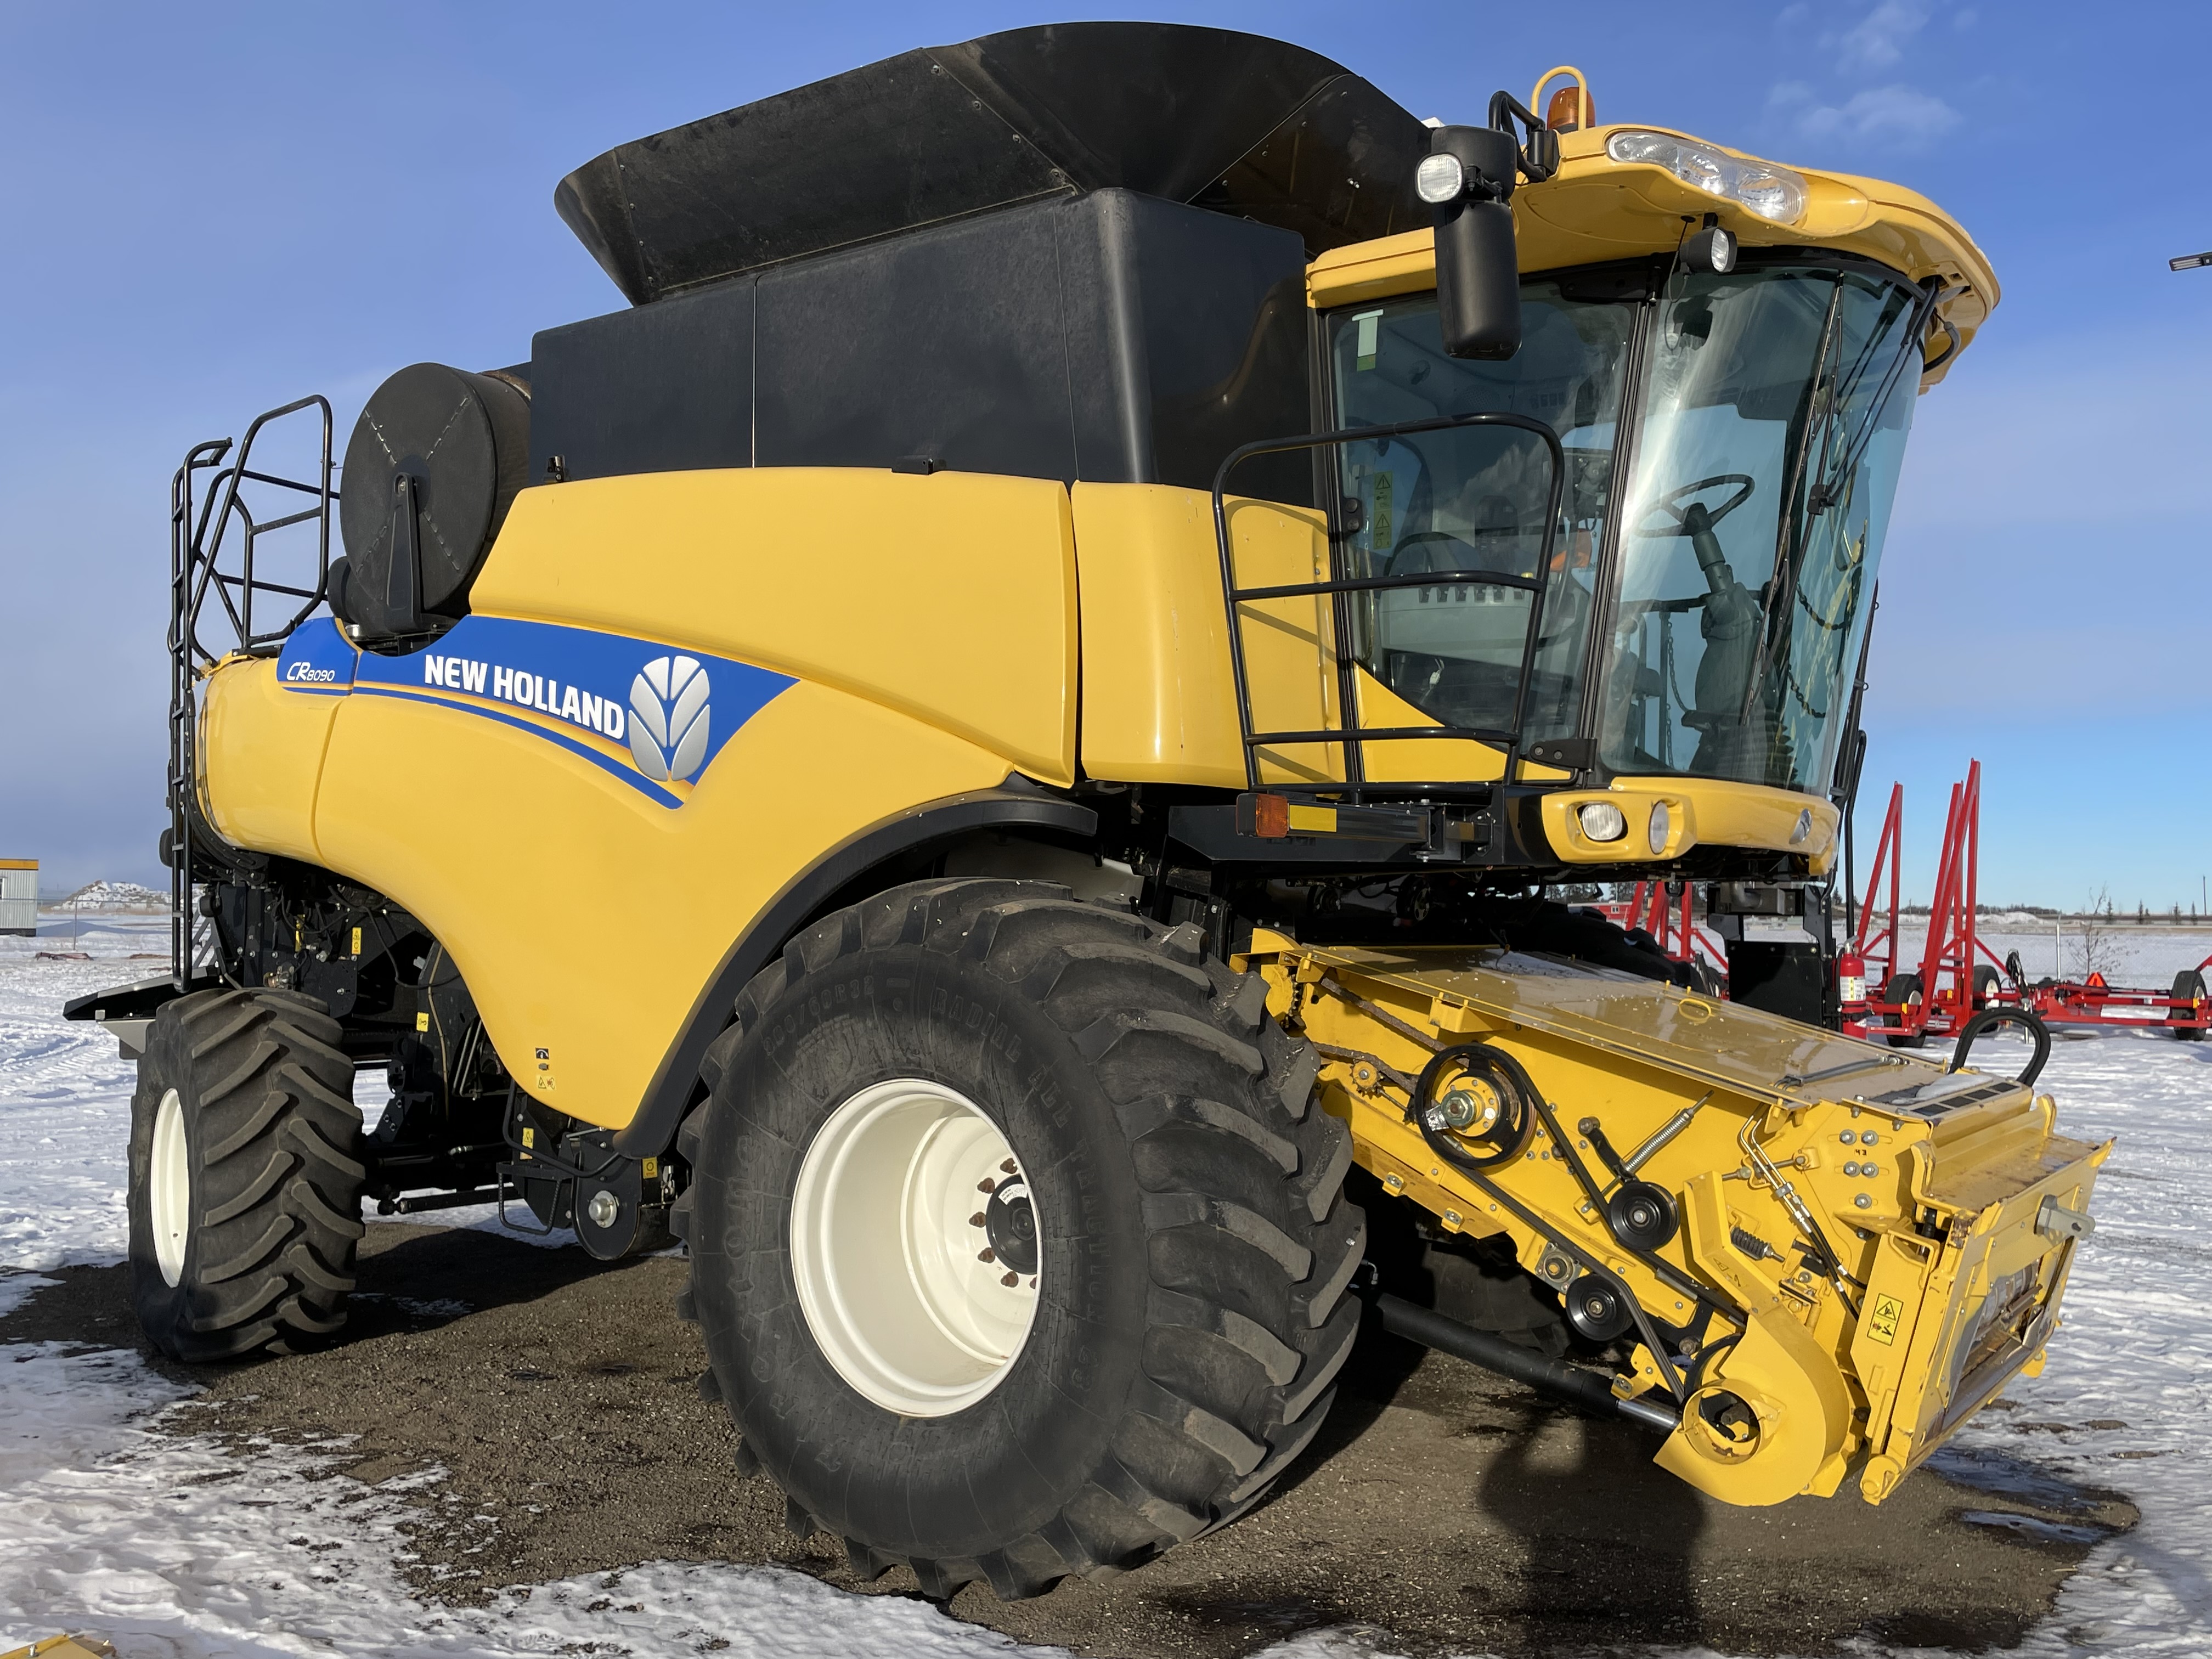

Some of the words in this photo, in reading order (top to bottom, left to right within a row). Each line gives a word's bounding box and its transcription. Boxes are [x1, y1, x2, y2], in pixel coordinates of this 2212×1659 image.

[286, 662, 335, 681] CR8090
[425, 654, 488, 693] NEW
[494, 665, 624, 739] HOLLAND
[932, 987, 1022, 1063] RADIAL
[1028, 1063, 1072, 1128] ALL
[1070, 1137, 1113, 1327] TRACTION
